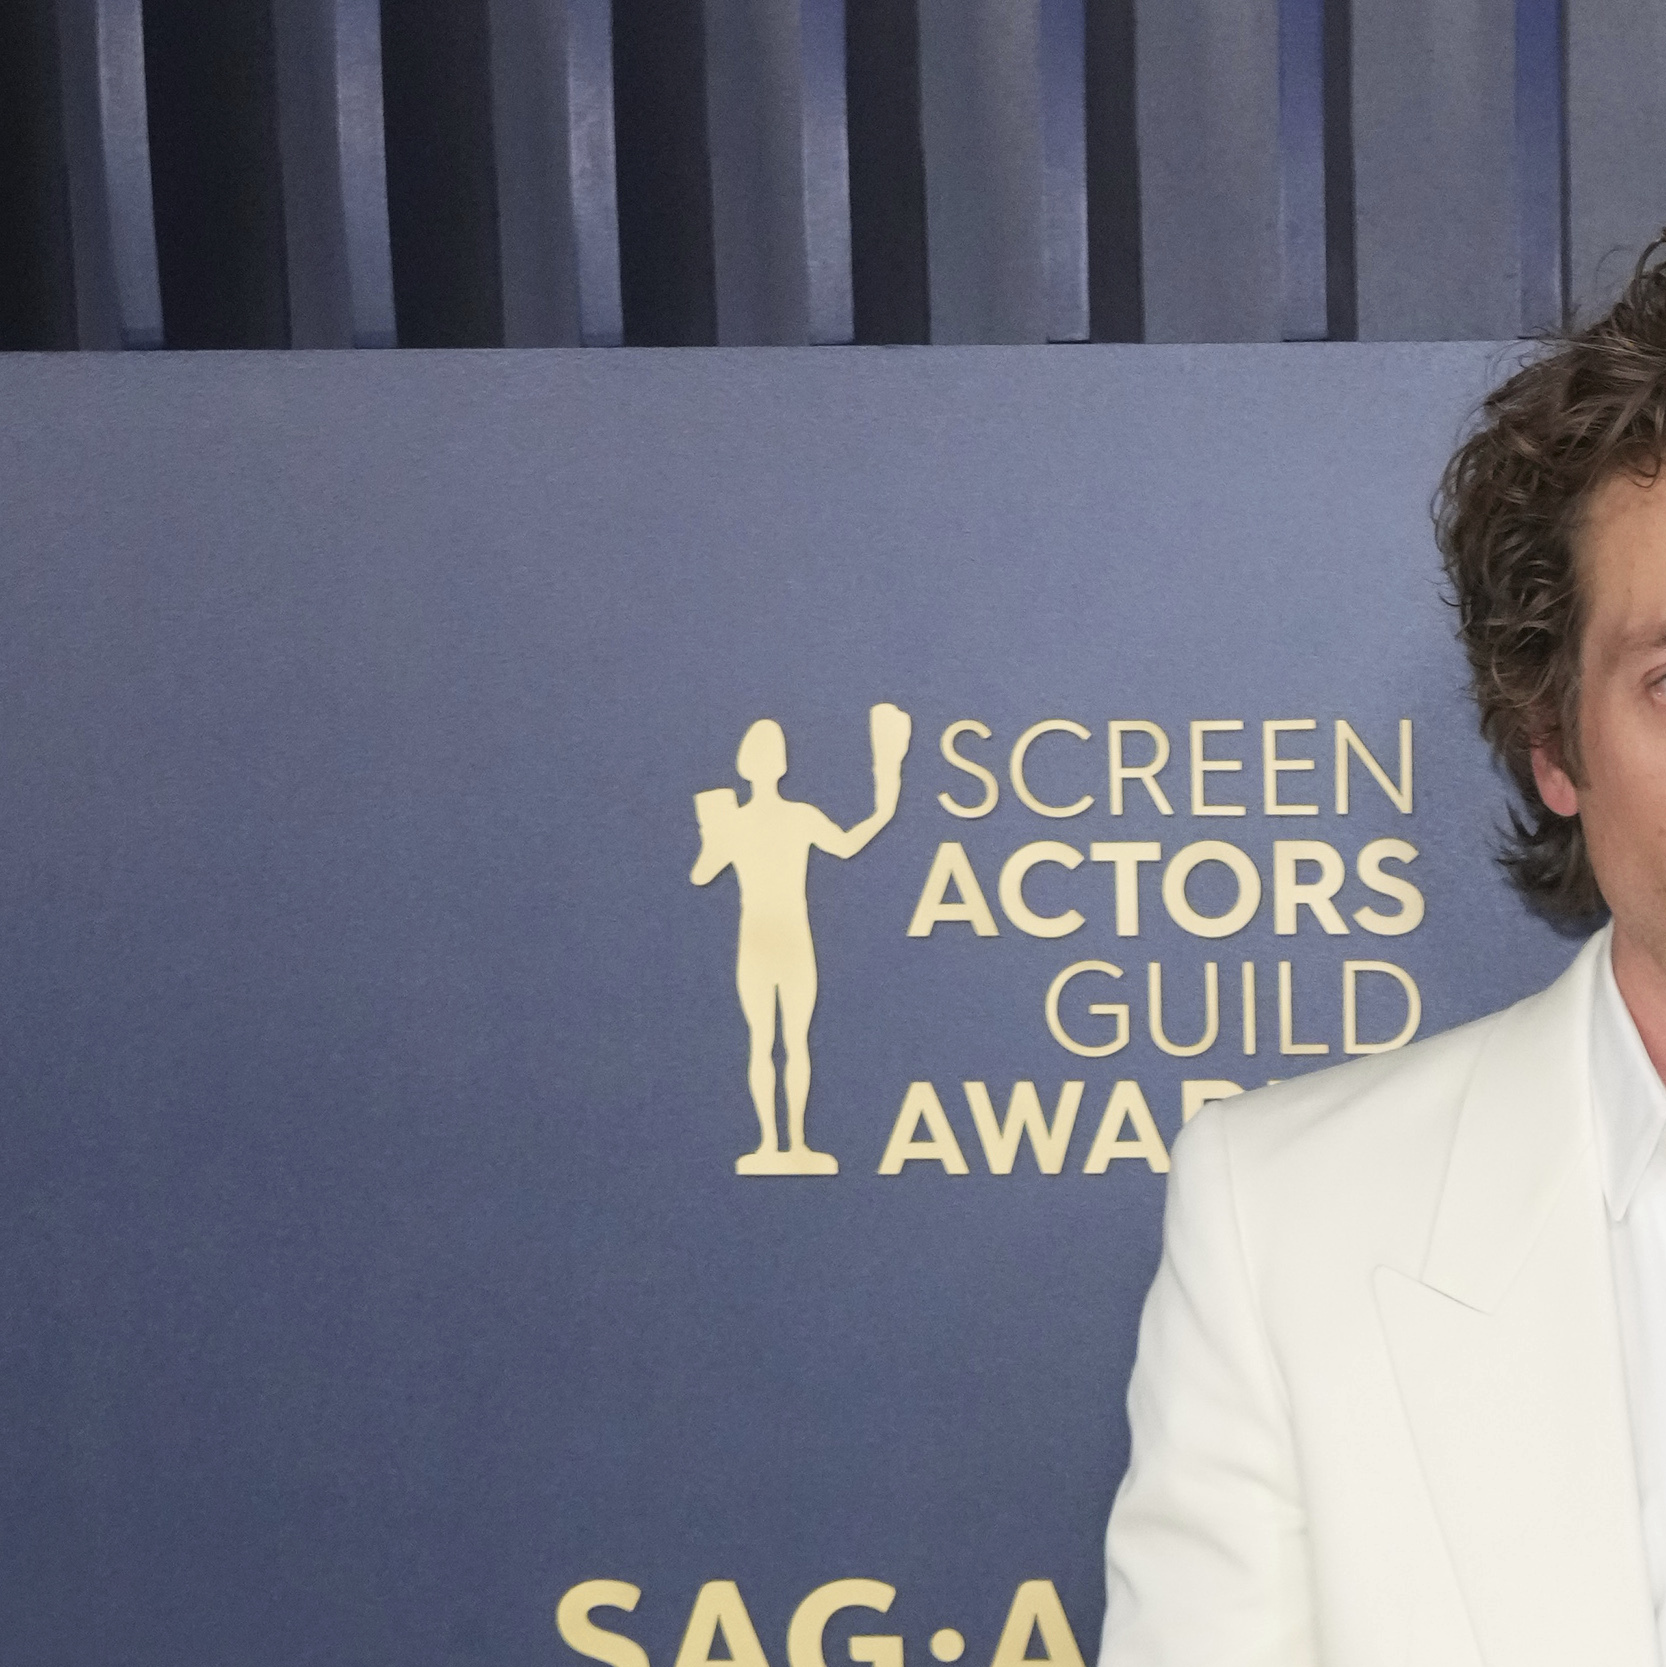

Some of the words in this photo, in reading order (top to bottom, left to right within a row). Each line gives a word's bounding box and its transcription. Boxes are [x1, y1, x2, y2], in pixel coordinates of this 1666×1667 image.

[937, 718, 1414, 819] SCREEN
[907, 838, 1427, 939] ACTORS
[1044, 959, 1423, 1058] GUILD
[876, 1079, 1286, 1177] AWA
